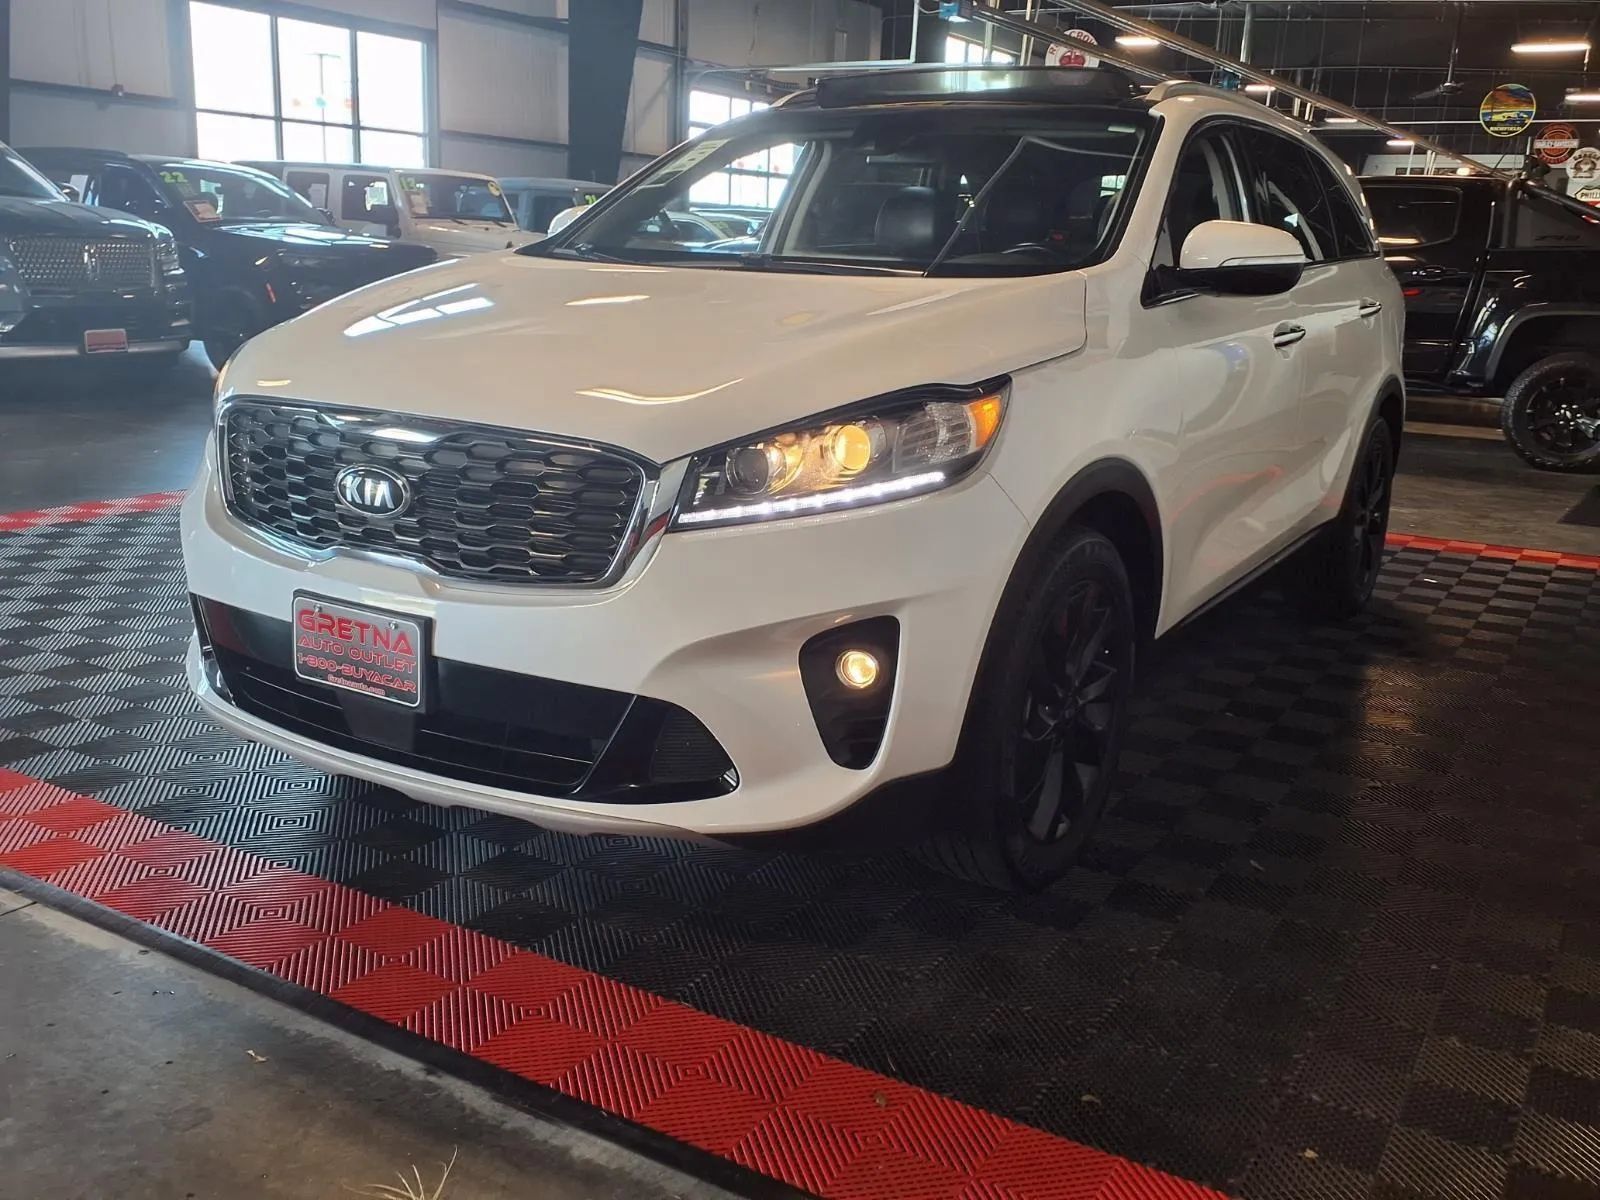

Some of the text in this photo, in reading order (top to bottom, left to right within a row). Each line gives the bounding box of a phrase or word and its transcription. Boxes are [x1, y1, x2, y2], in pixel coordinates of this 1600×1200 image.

[160, 171, 188, 184] 22
[341, 474, 395, 509] KIA
[298, 608, 414, 656] GRETNA
[297, 633, 417, 674] AUTO OUTLET
[297, 651, 417, 694] 1-800-BUYACAR
